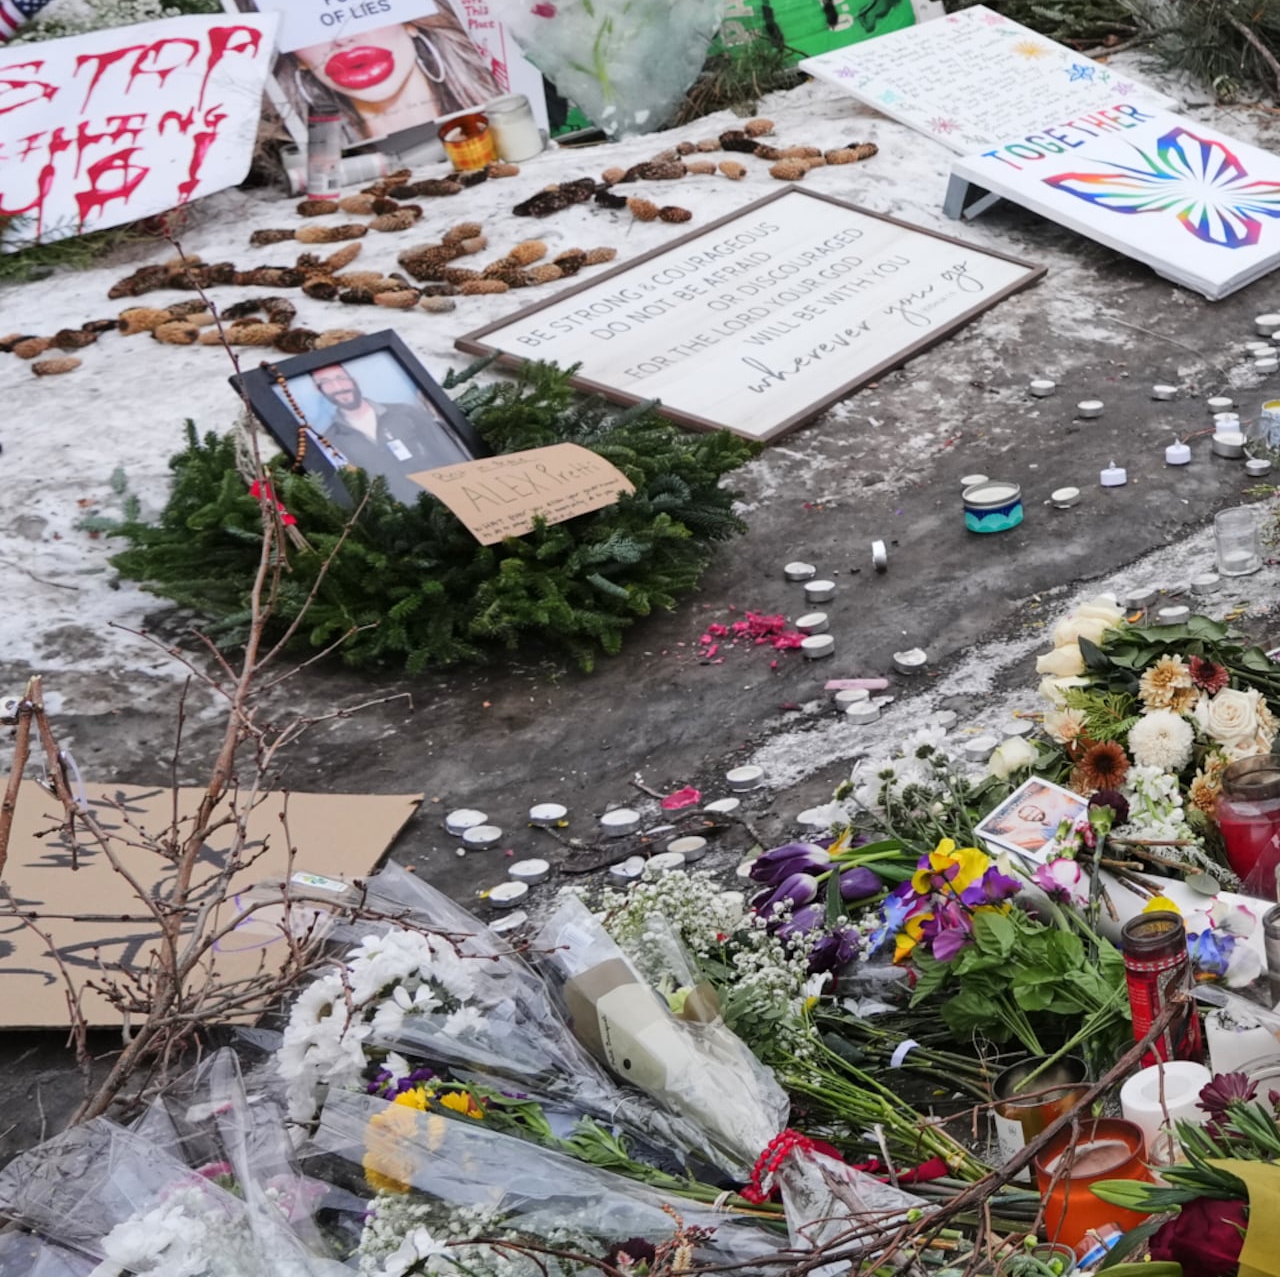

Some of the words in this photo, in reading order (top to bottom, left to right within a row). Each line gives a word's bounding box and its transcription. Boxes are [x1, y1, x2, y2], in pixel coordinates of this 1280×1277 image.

[319, 10, 345, 27] OF
[0, 25, 263, 115] STOP
[981, 103, 1156, 171] TOGETHER
[517, 328, 556, 347] BE
[550, 287, 643, 333] STRONG
[652, 221, 781, 286] COURAGEOUS
[590, 321, 632, 341] DO
[628, 297, 677, 324] NOT
[673, 281, 708, 301] BE
[703, 250, 772, 289] AFRAID
[707, 292, 746, 312] OR
[736, 227, 864, 297] DISCOURAGED
[744, 319, 801, 348] WILL
[792, 304, 828, 323] BE
[823, 277, 876, 306] WITH
[871, 254, 911, 279] YOU
[624, 354, 677, 380] FOR
[668, 332, 721, 360] THE
[711, 306, 772, 338] LORD
[764, 278, 824, 308] YOUR
[818, 254, 864, 282] GOD
[741, 319, 873, 395] wherever
[882, 283, 935, 327] you
[941, 260, 985, 293] go
[461, 472, 551, 512] ALEX
